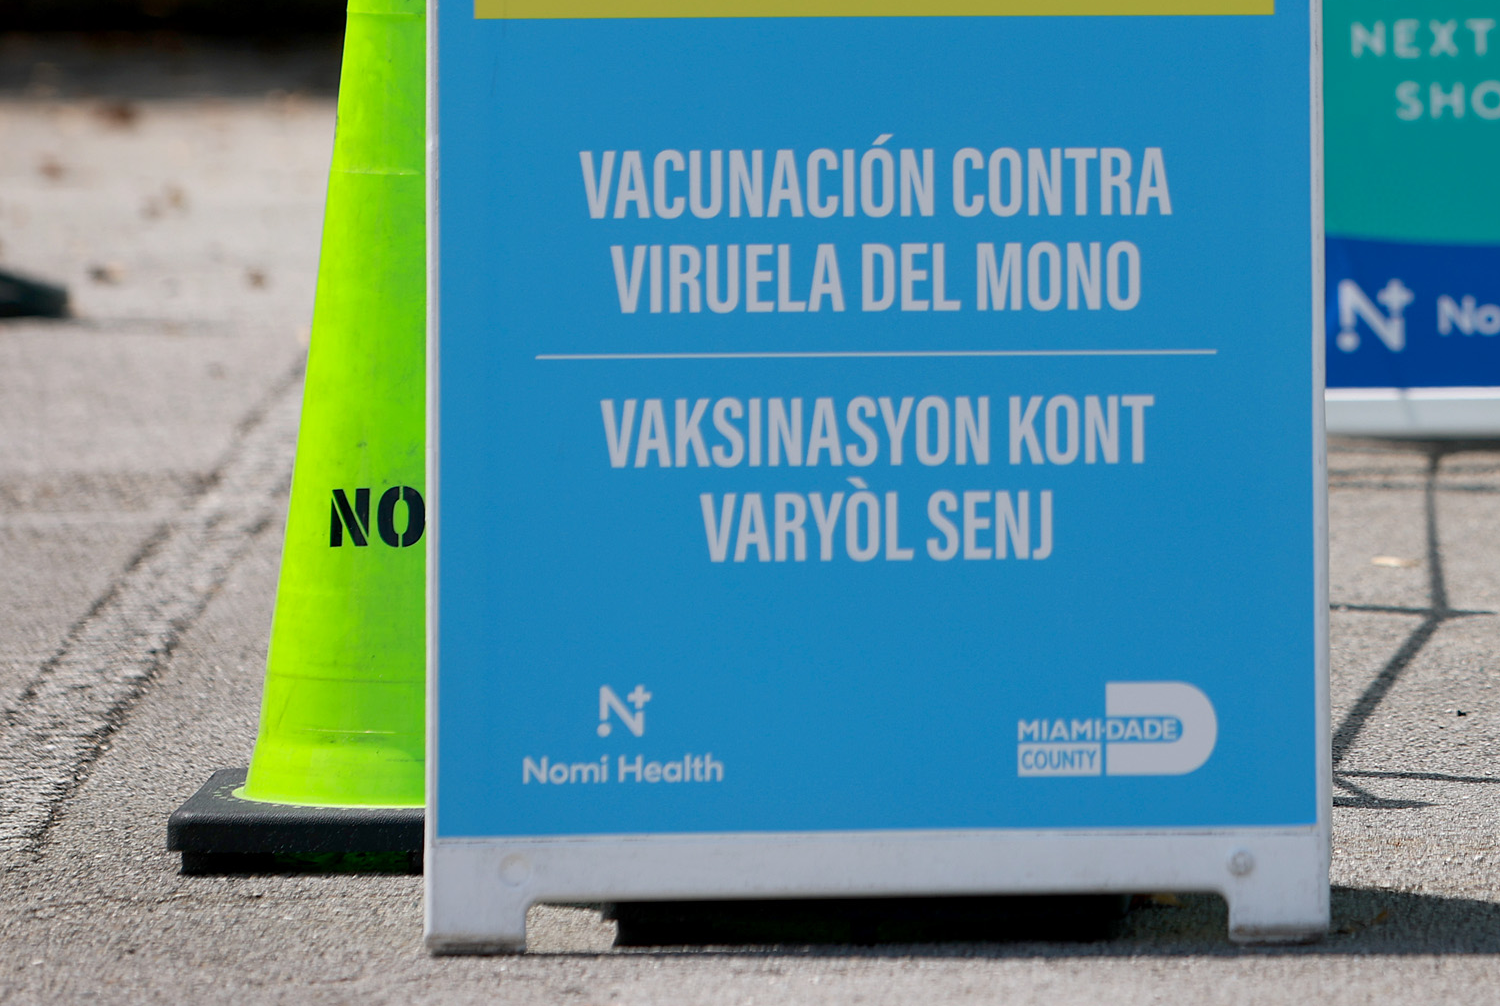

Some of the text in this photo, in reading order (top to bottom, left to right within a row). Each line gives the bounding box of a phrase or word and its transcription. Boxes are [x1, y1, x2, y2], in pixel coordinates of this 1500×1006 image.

[1350, 18, 1495, 59] NEXT
[579, 133, 1173, 220] VACUNACIÓN CONTRA
[610, 240, 1142, 314] VIRUELA DEL MONO
[600, 394, 1155, 469] VAKSINASYON KONT
[330, 485, 426, 548] NO
[699, 476, 1054, 563] VARYÒL SENJ
[522, 753, 724, 785] Nomi Health
[1021, 749, 1098, 771] COUNTY
